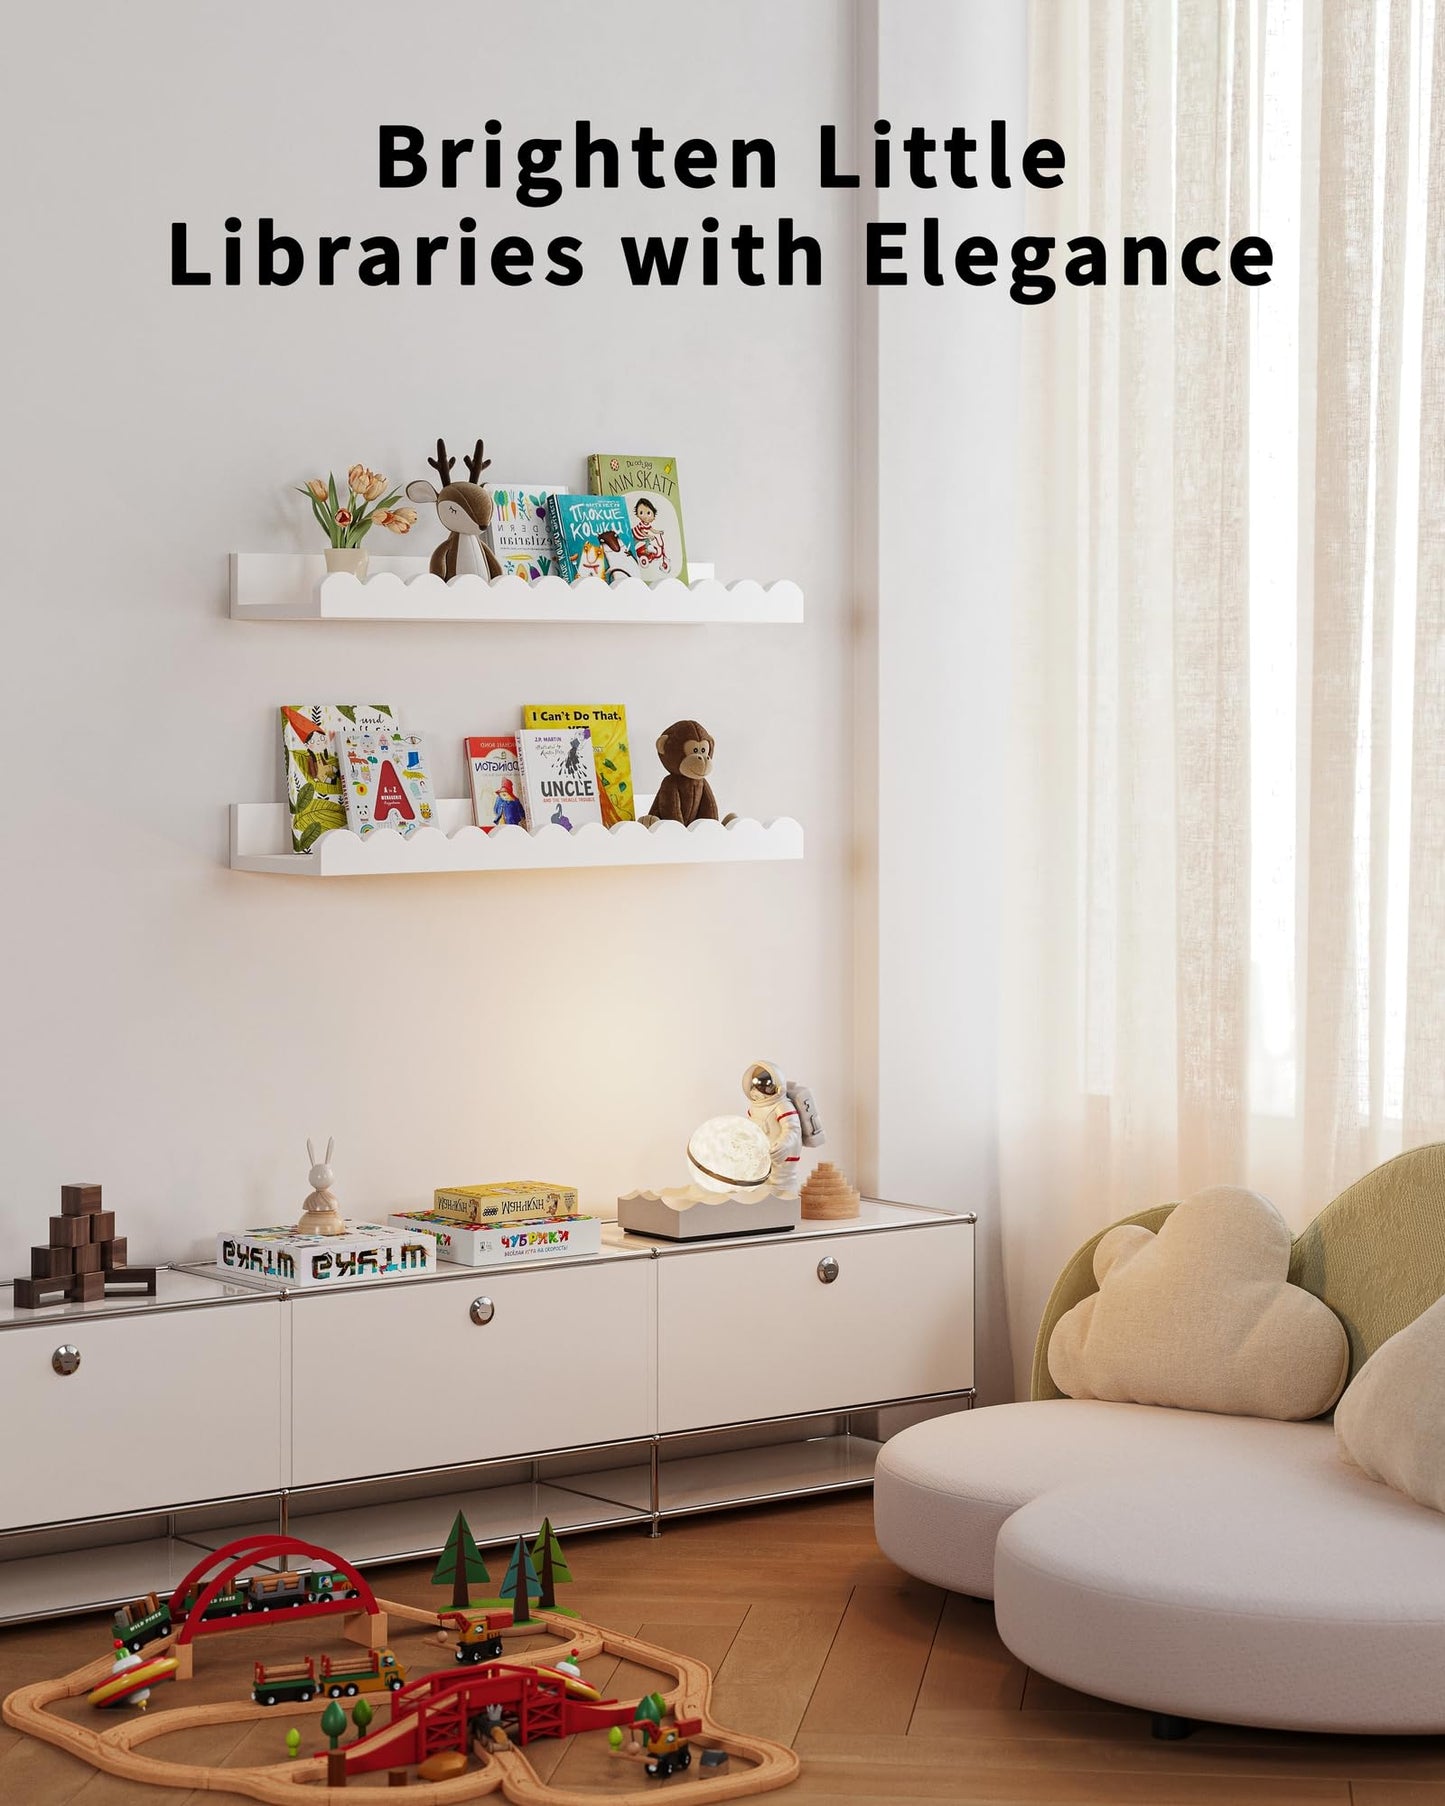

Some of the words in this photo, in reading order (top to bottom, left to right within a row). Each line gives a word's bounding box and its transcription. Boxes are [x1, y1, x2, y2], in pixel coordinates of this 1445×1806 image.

[608, 472, 634, 496] MIN
[636, 470, 676, 496] SKATT
[361, 714, 385, 724] und
[533, 712, 537, 721] I
[540, 711, 570, 721] Can't
[574, 711, 589, 721] Do
[592, 711, 622, 721] That,
[541, 780, 594, 797] UNCLE
[501, 1230, 569, 1248] ЧУБРИКИ
